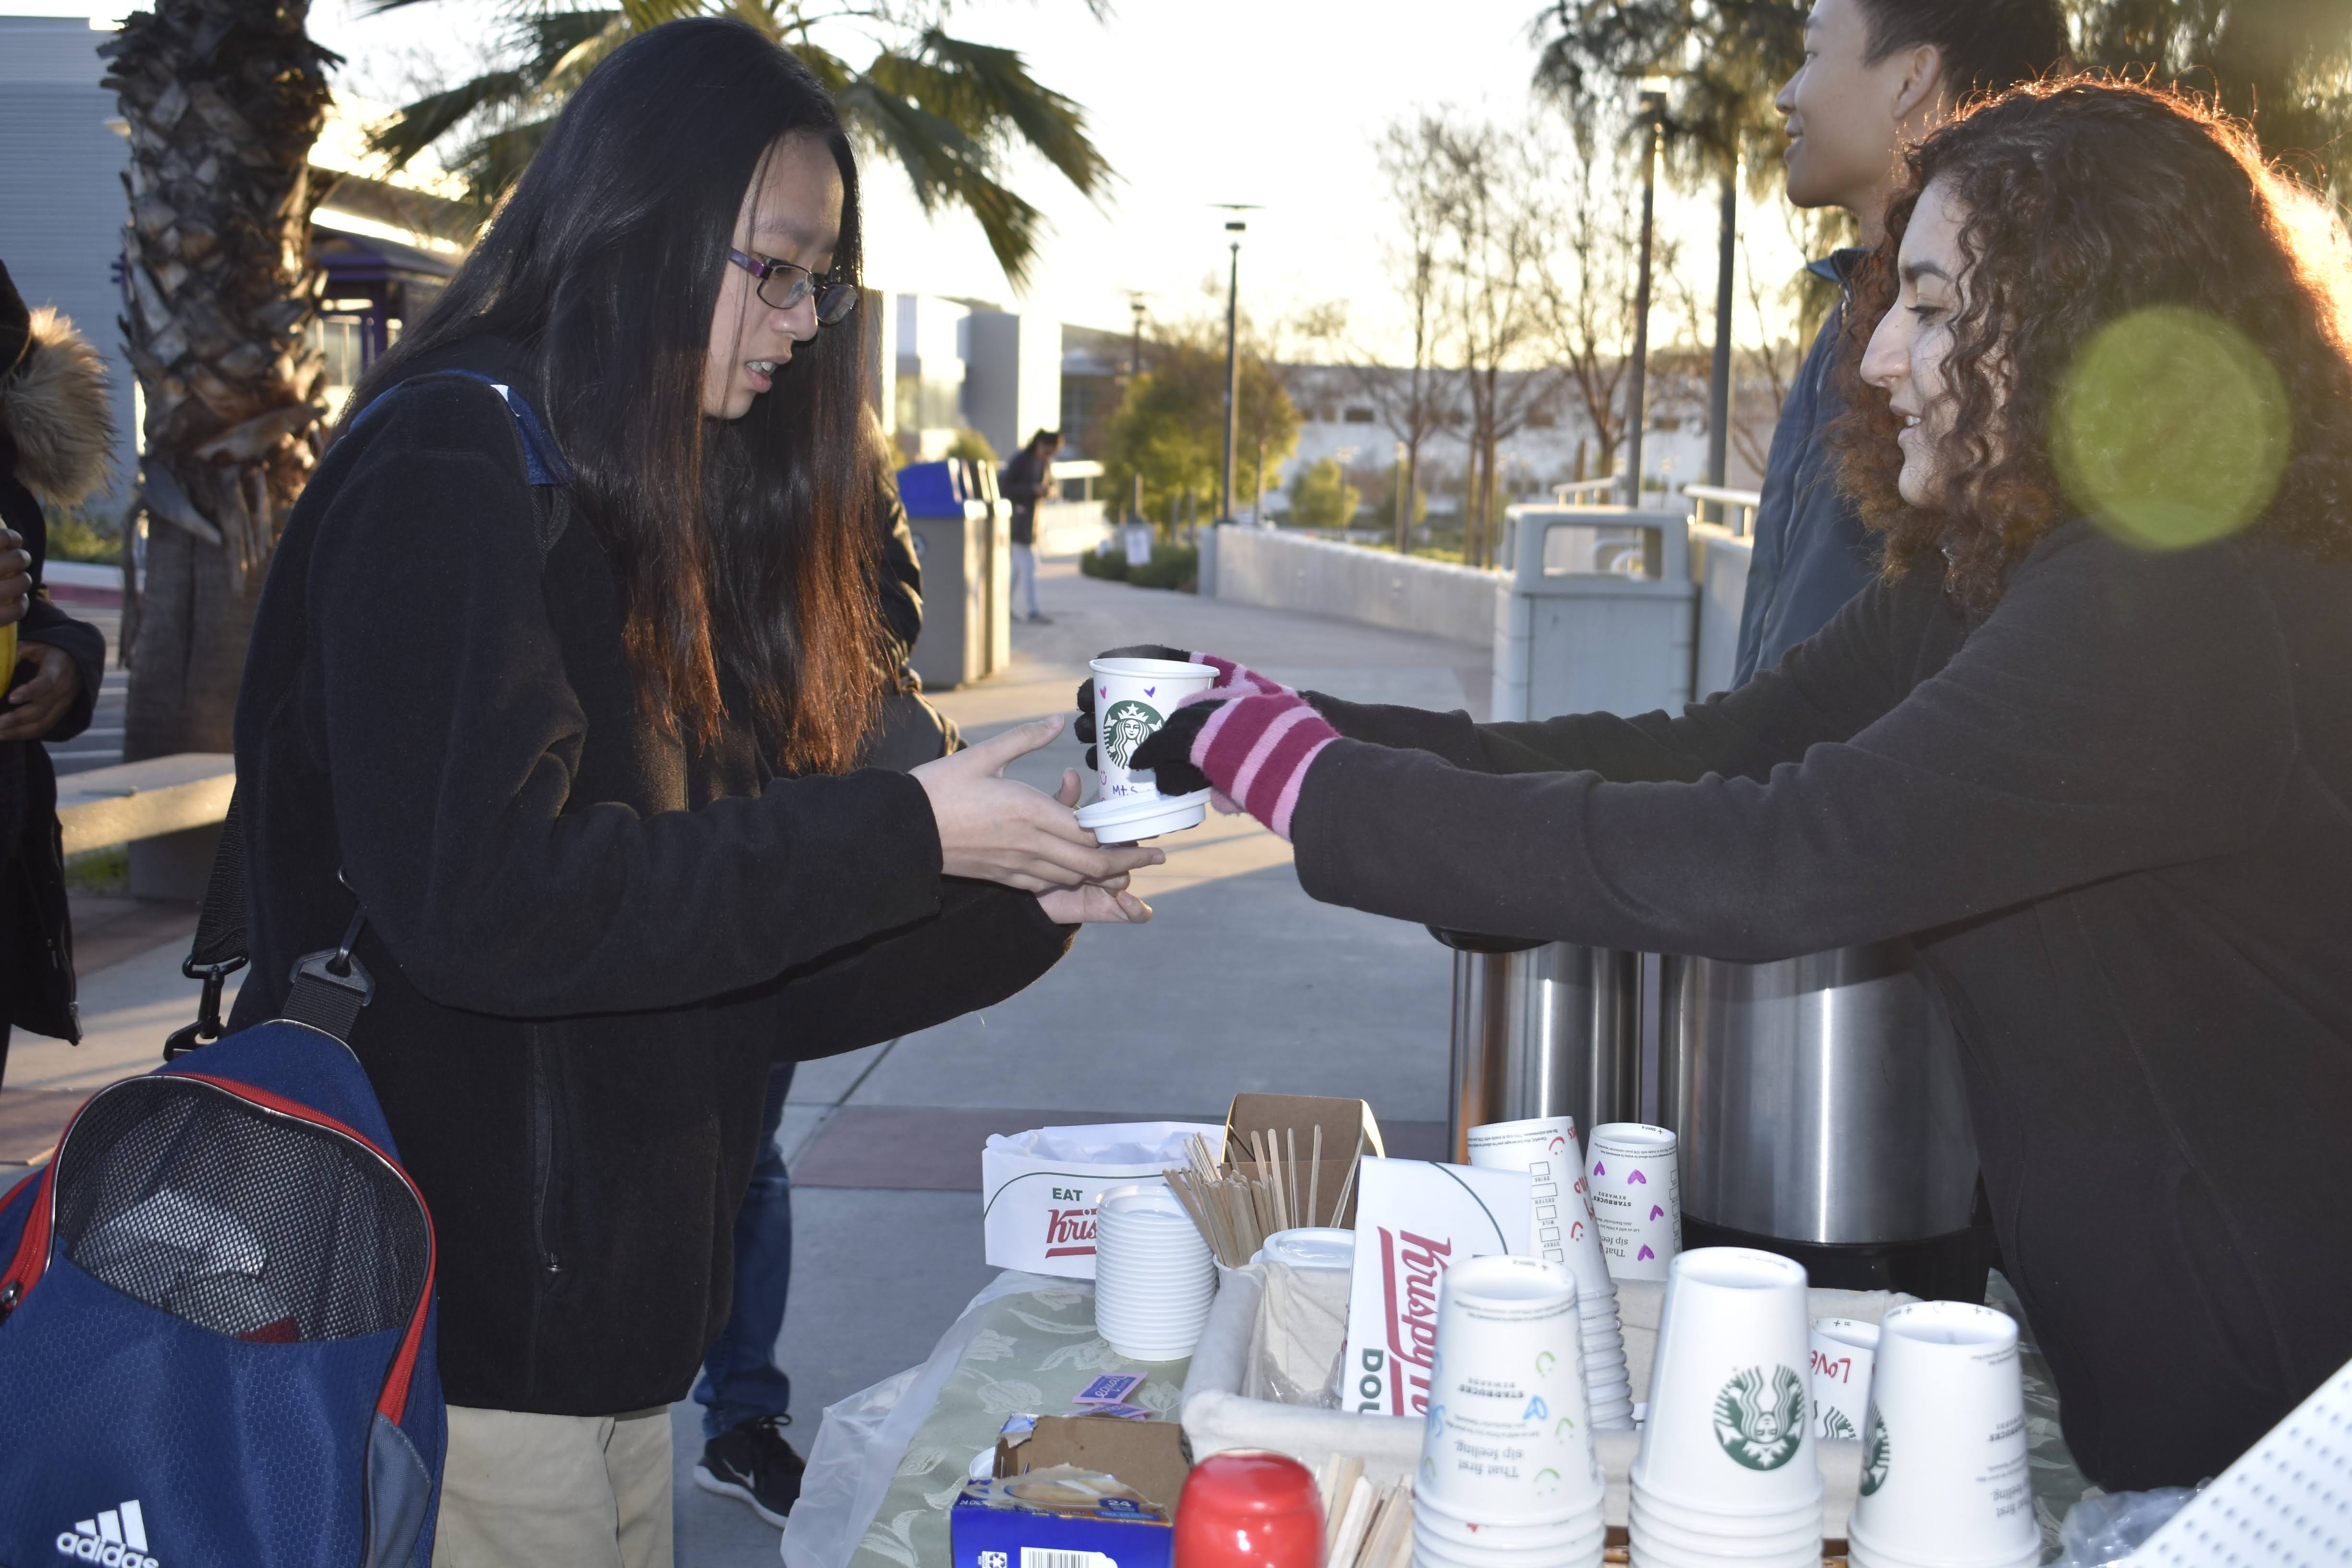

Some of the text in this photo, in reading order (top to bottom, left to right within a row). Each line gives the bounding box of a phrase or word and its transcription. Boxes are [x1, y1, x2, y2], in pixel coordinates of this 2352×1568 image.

[1052, 1187, 1083, 1201] EAT
[1598, 1191, 1626, 1200] REWARDS
[1615, 1237, 1629, 1246] sip
[1605, 1247, 1625, 1257] That
